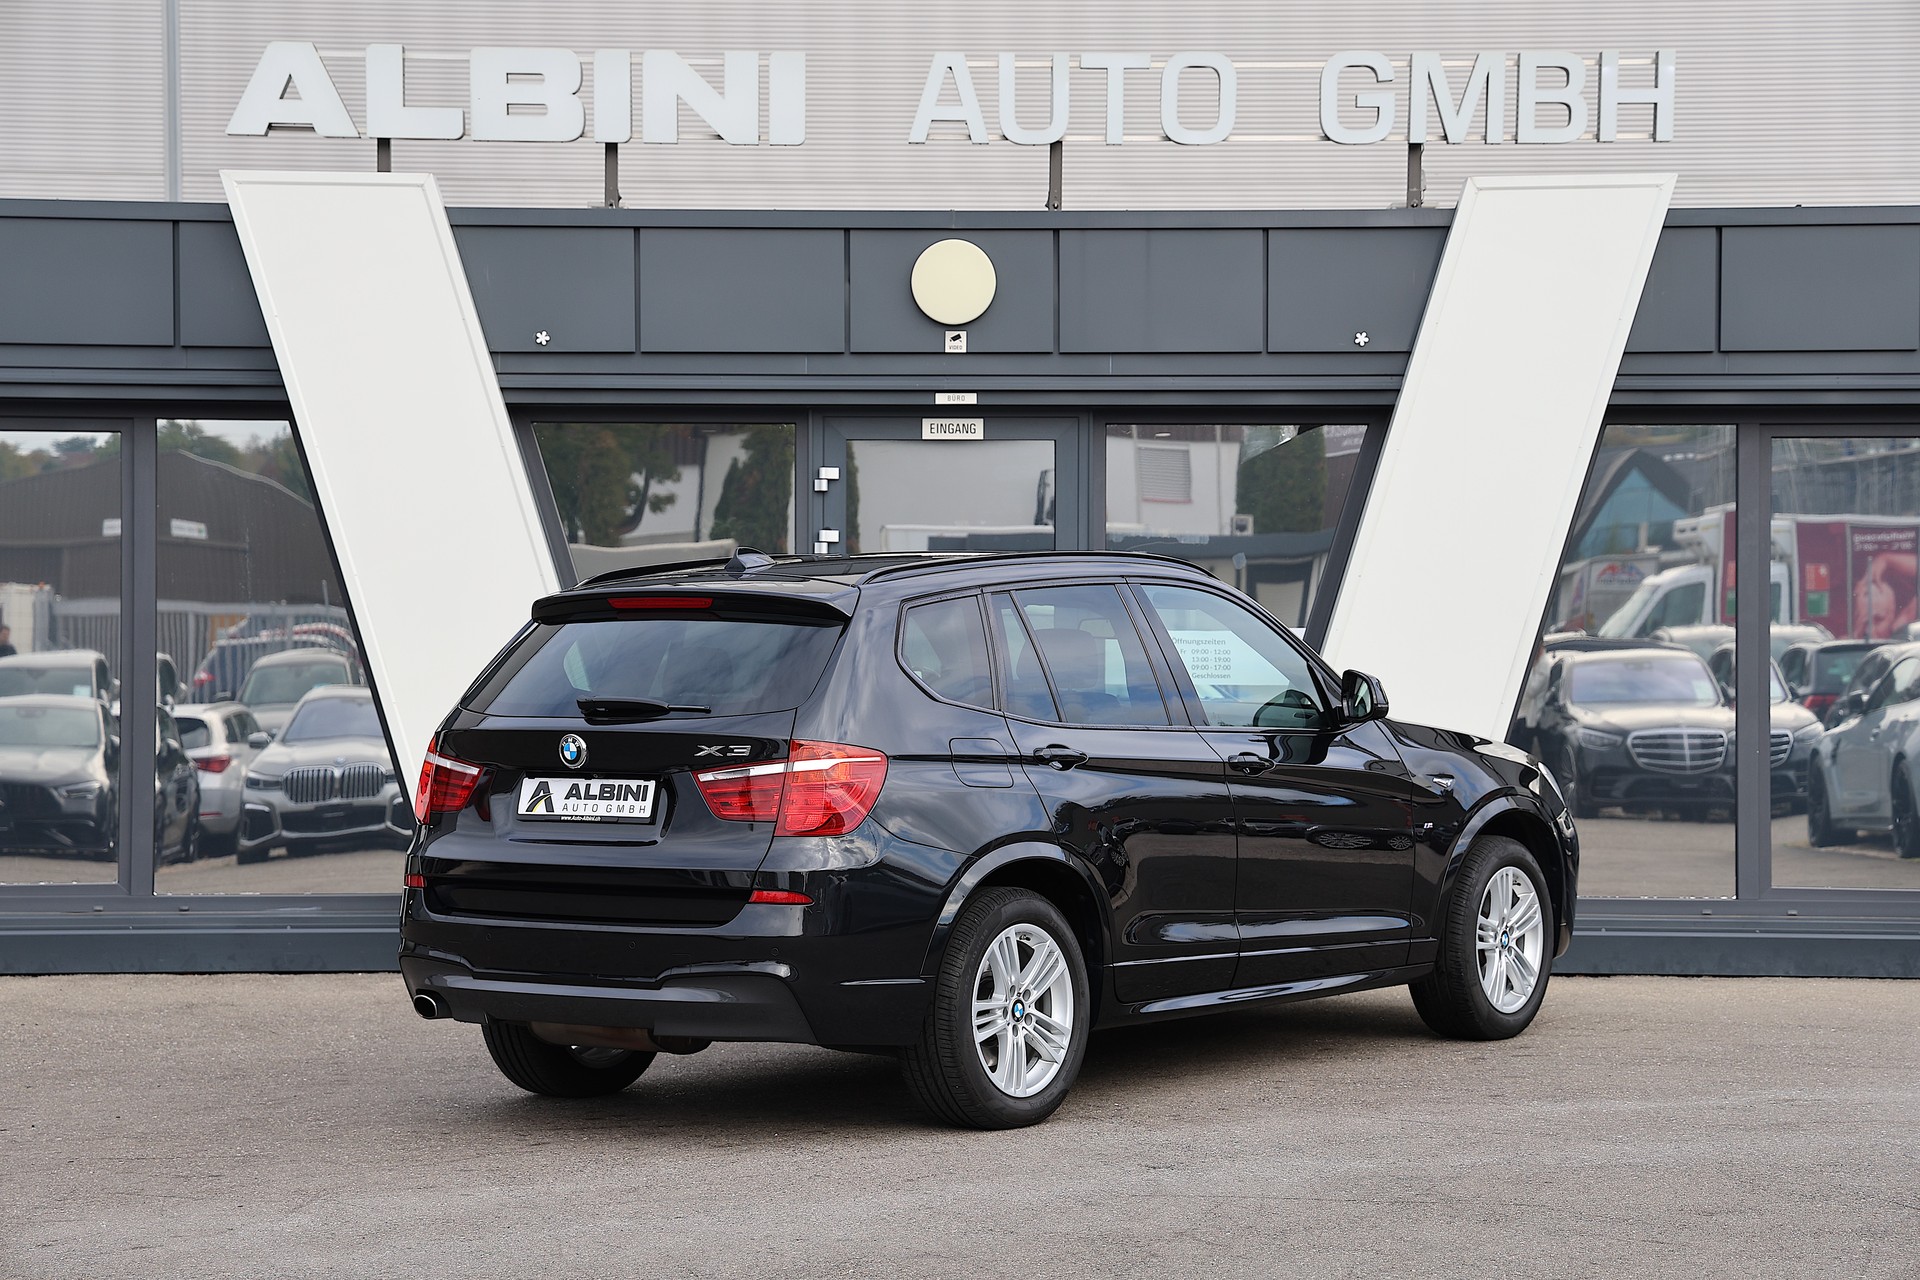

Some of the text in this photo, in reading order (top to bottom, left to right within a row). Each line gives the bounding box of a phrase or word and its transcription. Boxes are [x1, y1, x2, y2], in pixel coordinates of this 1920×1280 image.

[226, 41, 1677, 146] ALBINI AUTO GMBH
[947, 394, 966, 402] BÜRO
[930, 423, 977, 434] EINGANG
[694, 744, 752, 757] X3
[564, 783, 649, 801] ALBINI
[562, 803, 646, 814] AUTO GMBH
